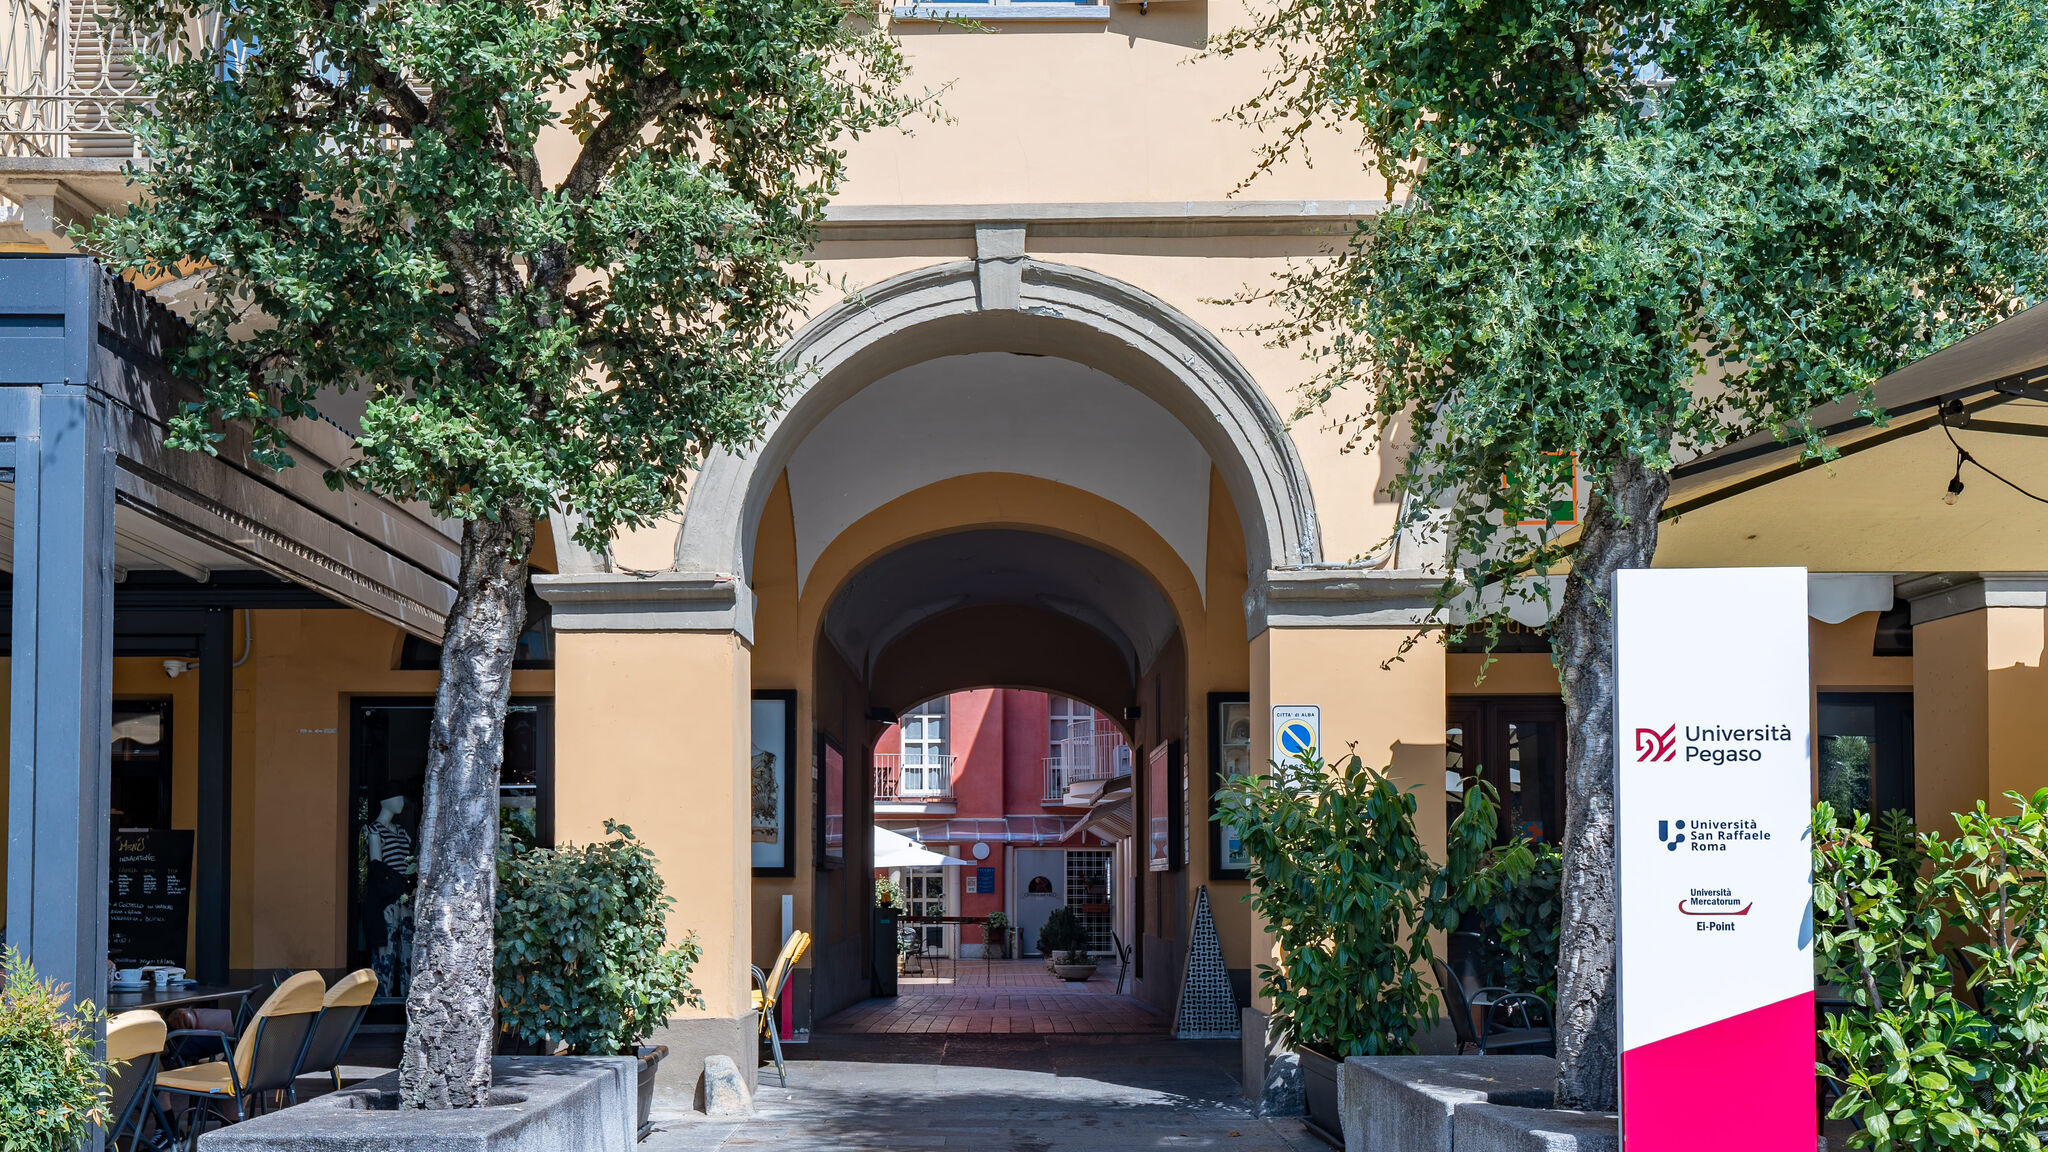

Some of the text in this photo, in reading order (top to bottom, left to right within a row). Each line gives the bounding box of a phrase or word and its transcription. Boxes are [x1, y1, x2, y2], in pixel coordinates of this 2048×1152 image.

[1686, 724, 1791, 742] Università
[1686, 746, 1762, 766] Pegaso
[1690, 819, 1757, 830] Università
[1690, 830, 1771, 841] San Raffaele
[1691, 842, 1727, 852] Roma
[1690, 888, 1731, 897] Università
[1690, 897, 1741, 906] Mercatorum
[1696, 921, 1735, 931] Ei-Point
